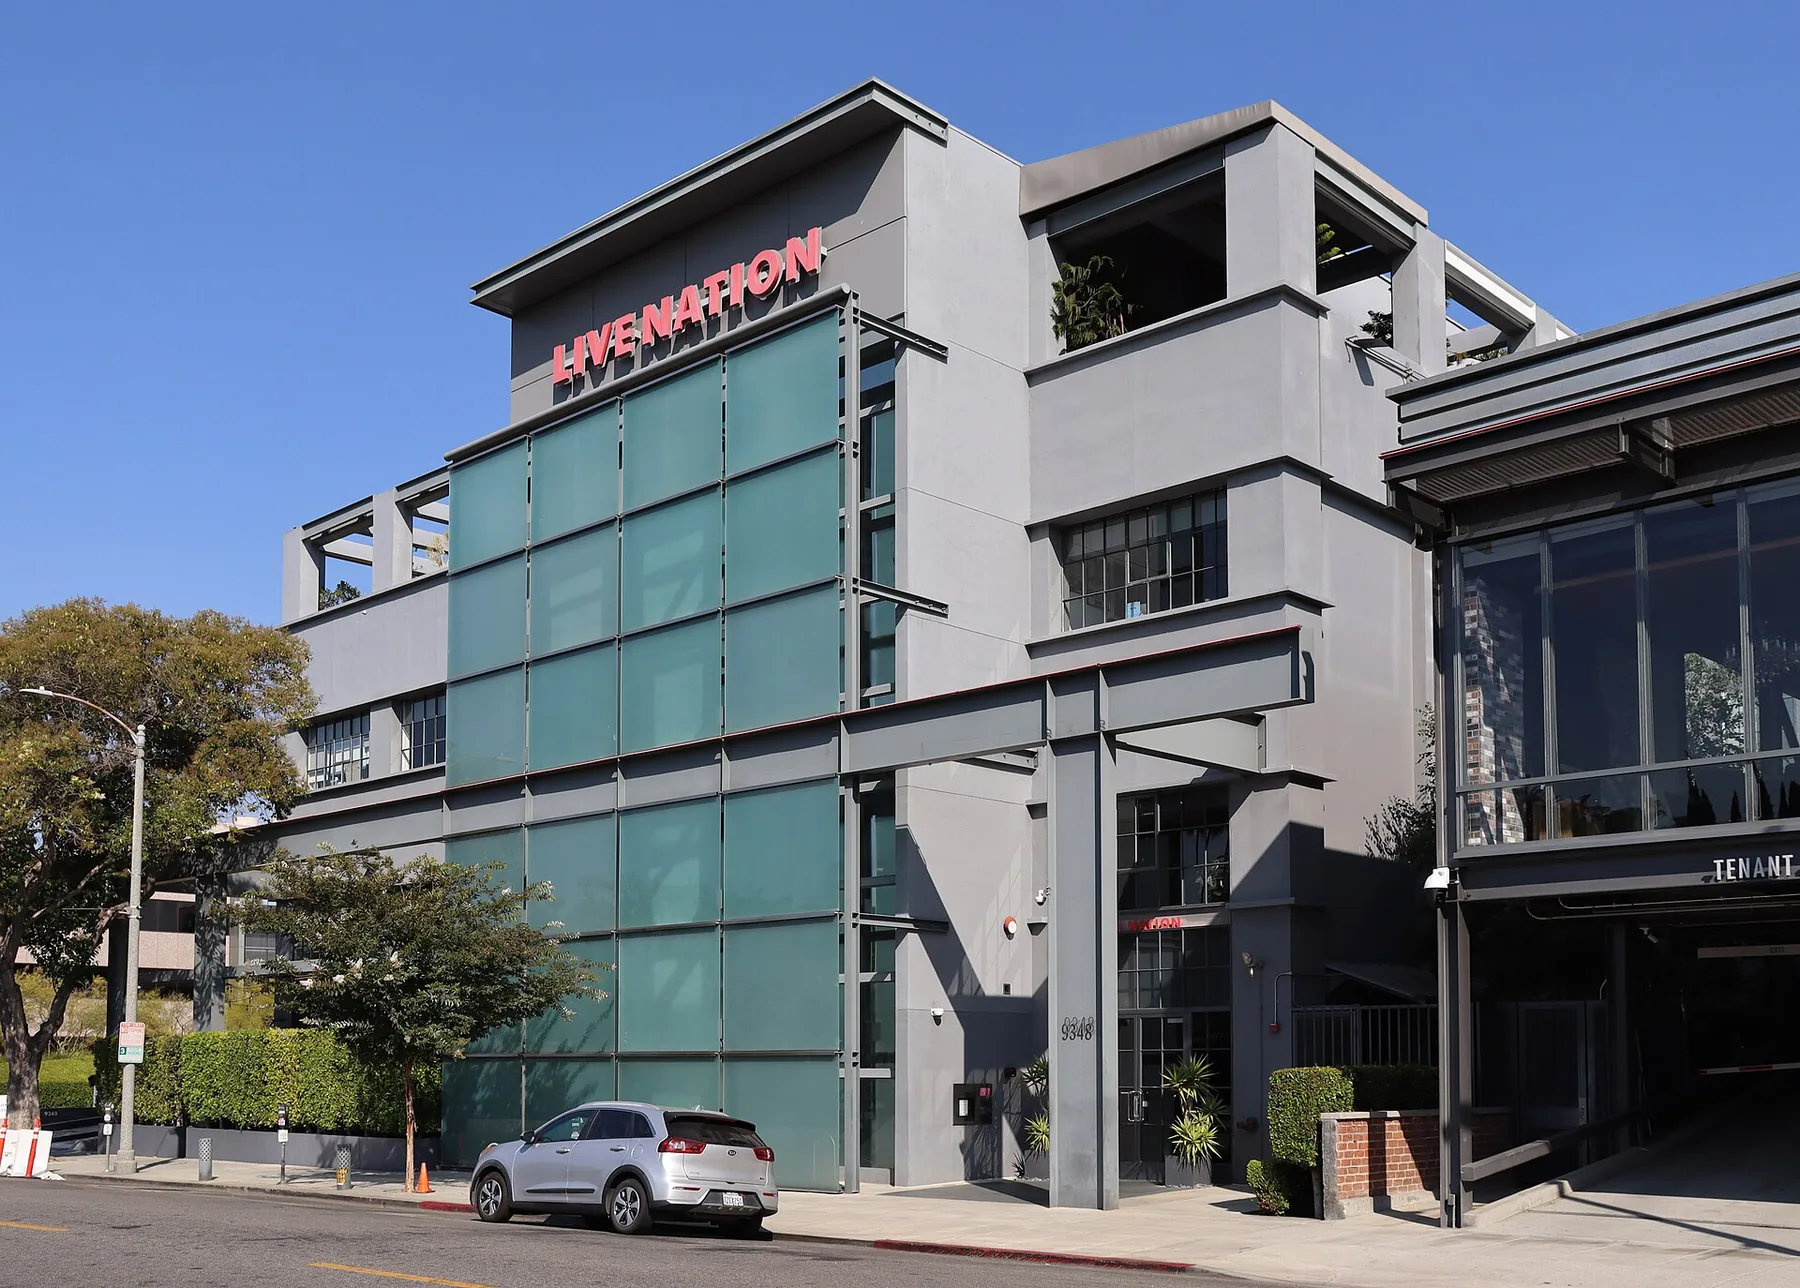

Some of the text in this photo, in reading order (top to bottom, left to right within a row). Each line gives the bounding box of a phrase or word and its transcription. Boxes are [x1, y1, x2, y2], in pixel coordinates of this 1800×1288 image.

[553, 226, 823, 385] LIVE NATION
[1713, 854, 1794, 881] TENANT
[1062, 1018, 1094, 1040] 9348
